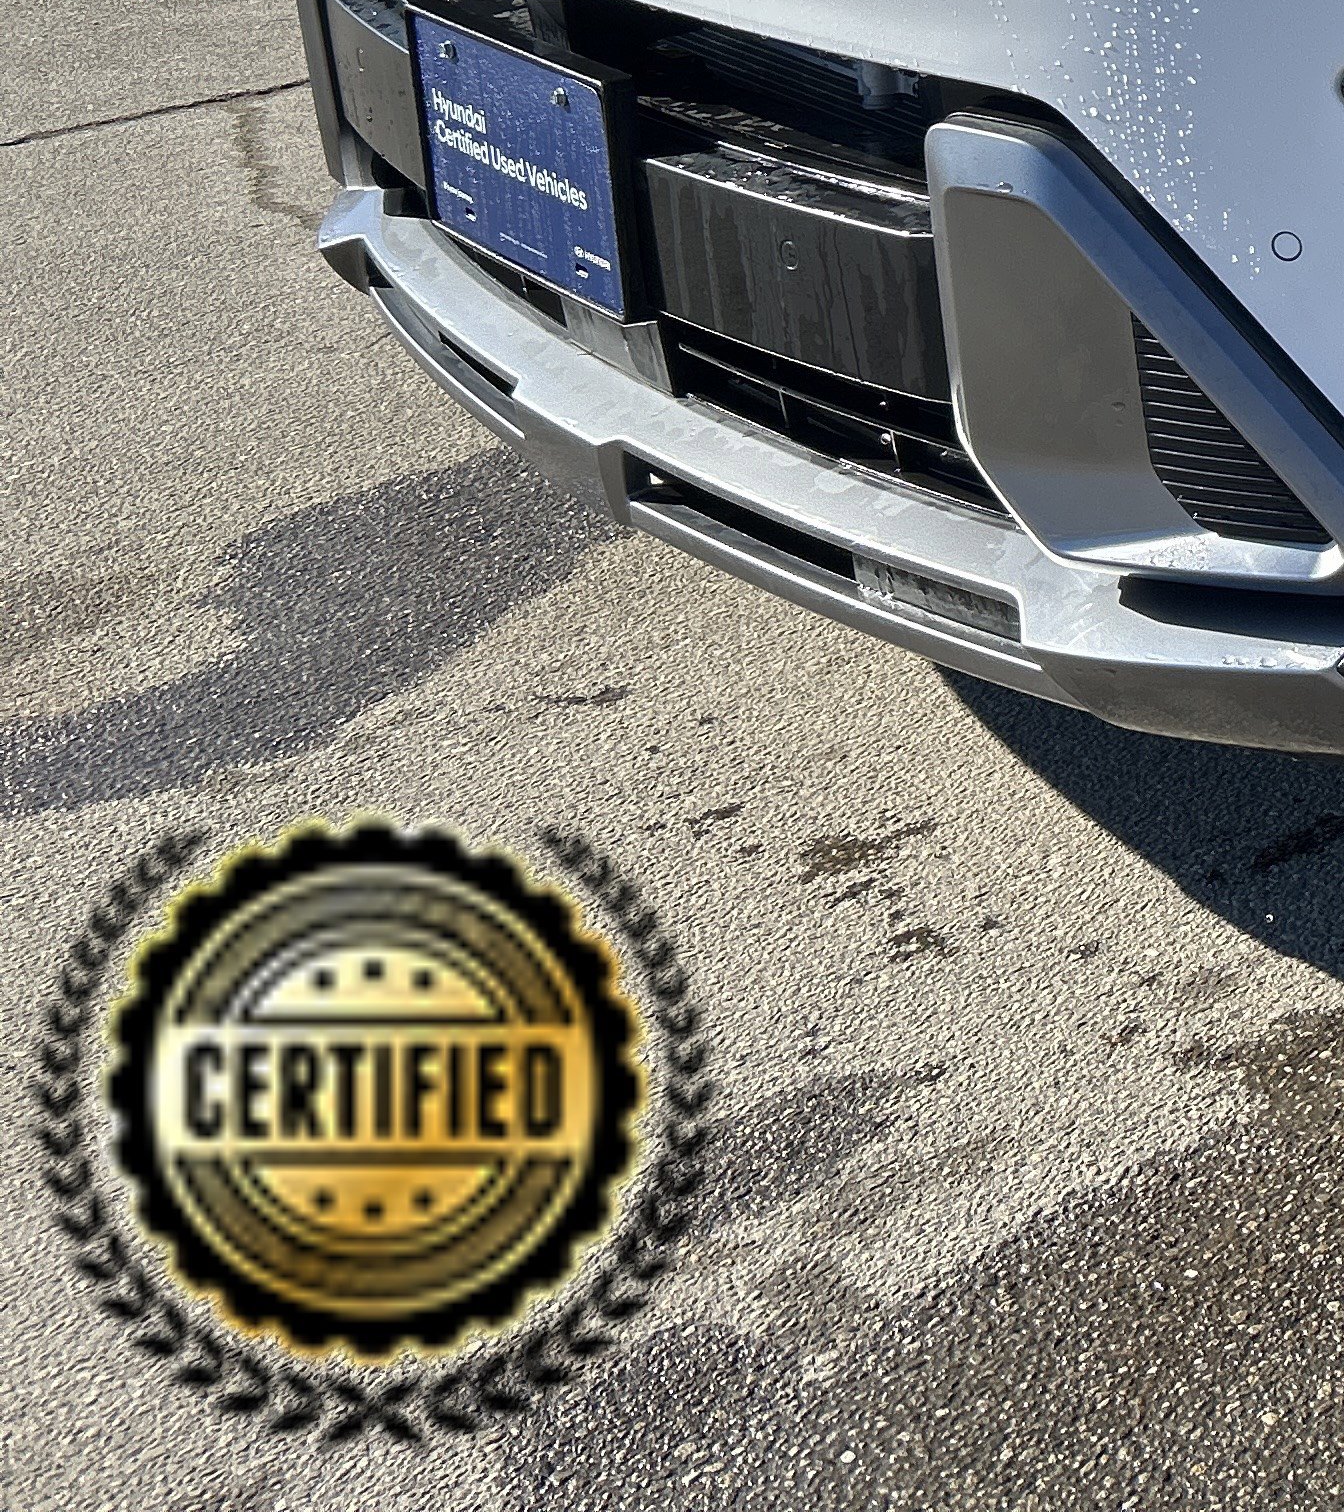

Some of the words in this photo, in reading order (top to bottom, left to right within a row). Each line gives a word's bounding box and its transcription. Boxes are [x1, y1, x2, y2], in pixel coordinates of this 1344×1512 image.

[432, 88, 487, 134] Hyundai
[435, 119, 490, 166] Certified
[490, 145, 527, 182] Used
[526, 161, 588, 211] Vehicles
